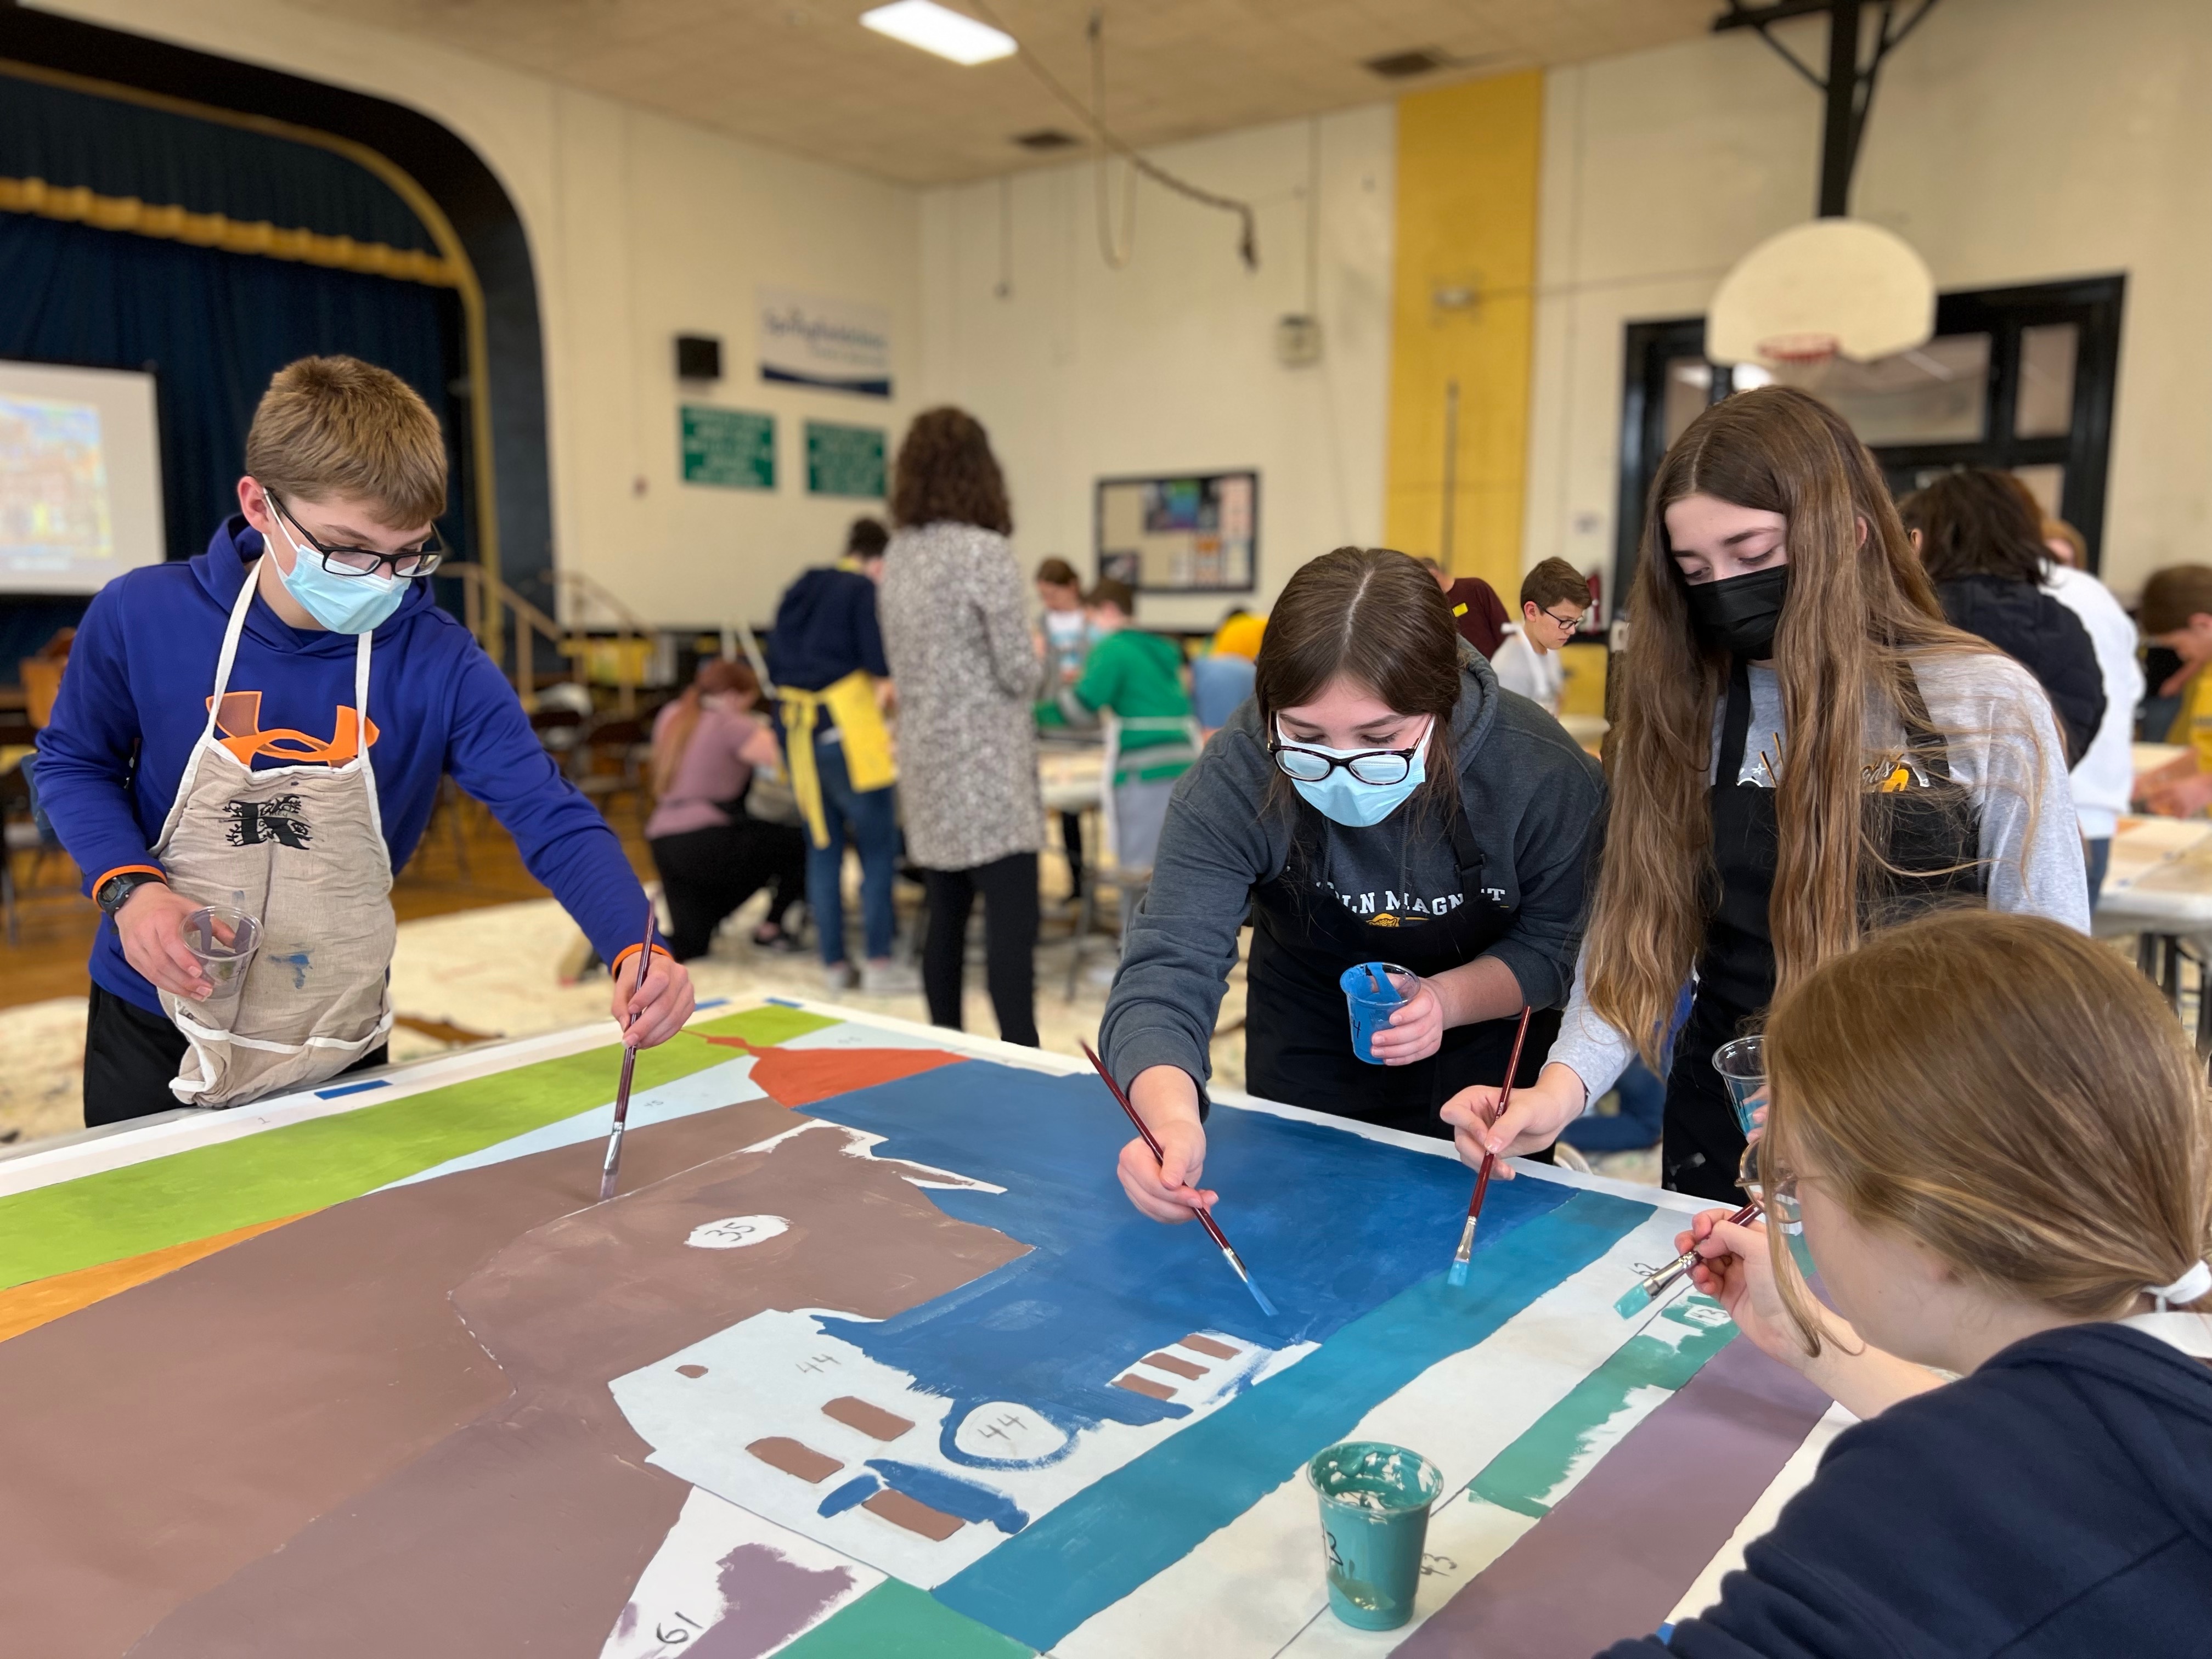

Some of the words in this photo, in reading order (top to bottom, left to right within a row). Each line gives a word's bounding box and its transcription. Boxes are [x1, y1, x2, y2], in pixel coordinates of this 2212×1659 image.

[1385, 888, 1505, 915] MAGNT
[704, 1222, 756, 1243] 35
[1690, 1309, 1729, 1321] 43
[795, 1353, 842, 1373] 44
[977, 1413, 1028, 1441] 44
[656, 1611, 704, 1645] 61
